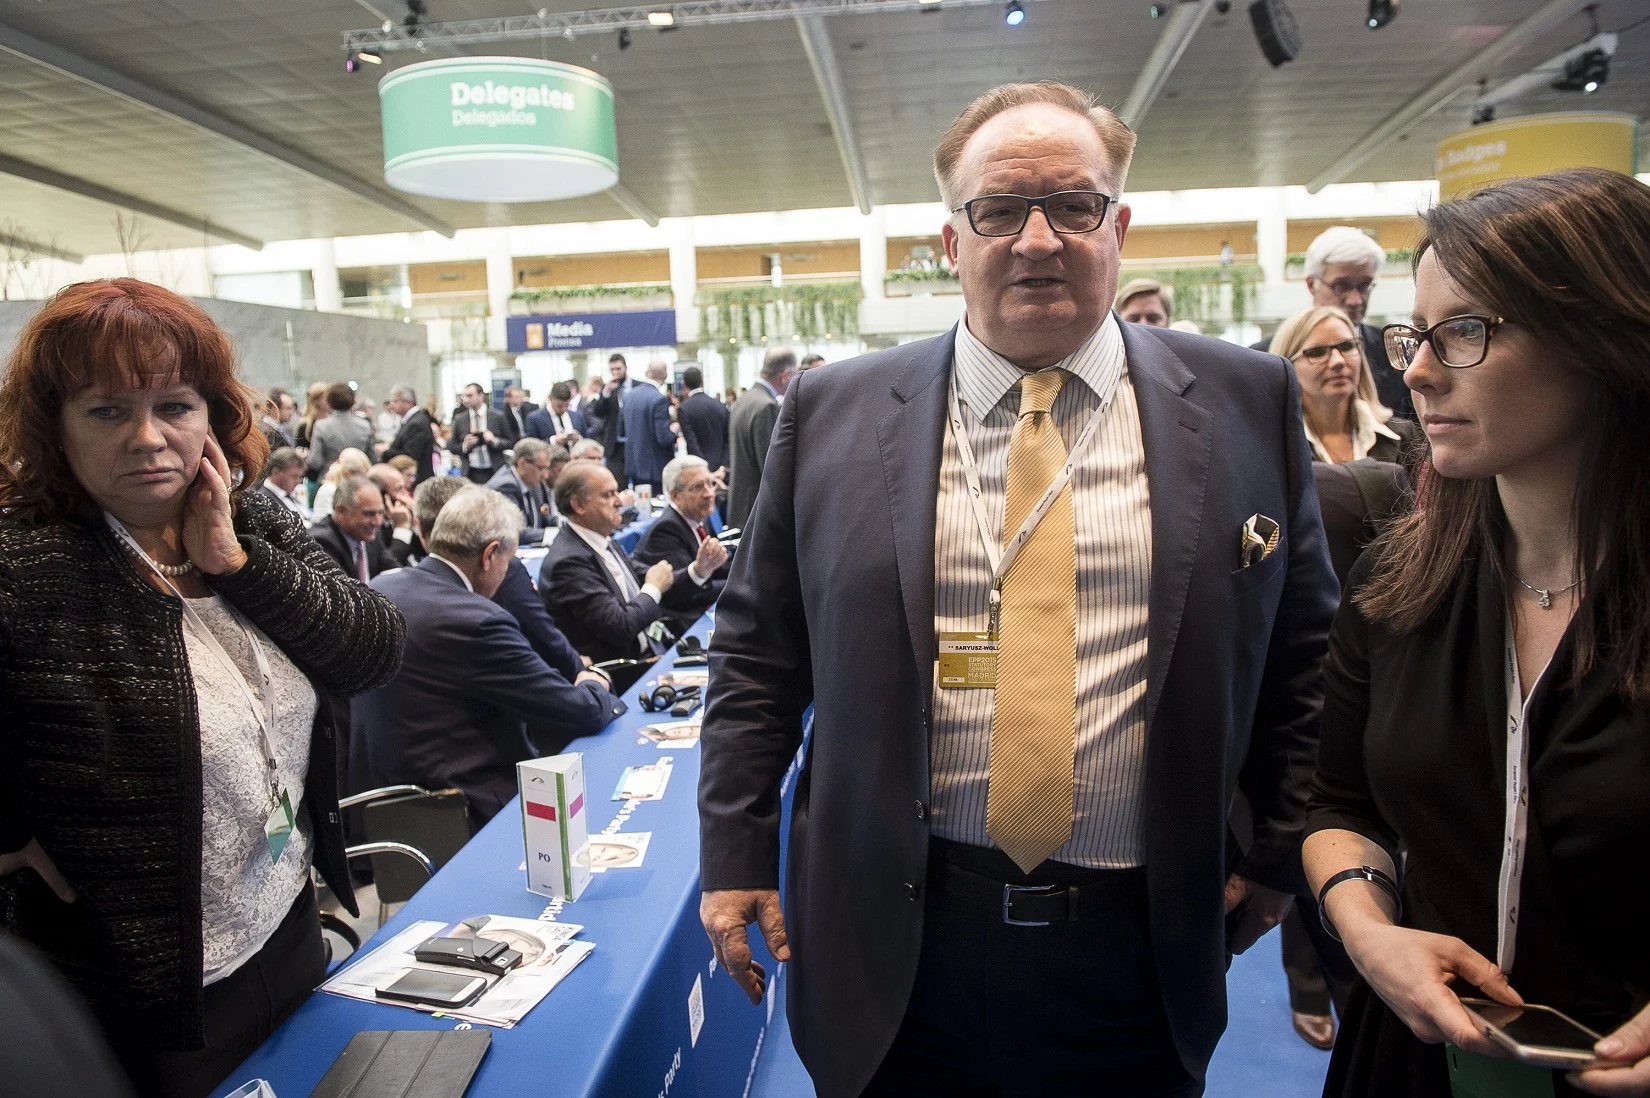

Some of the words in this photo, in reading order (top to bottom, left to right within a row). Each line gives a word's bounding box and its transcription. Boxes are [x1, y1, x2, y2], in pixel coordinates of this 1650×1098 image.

[450, 80, 575, 111] Delegates
[451, 109, 537, 128] Delegados
[547, 321, 594, 338] Media
[538, 852, 551, 863] PO
